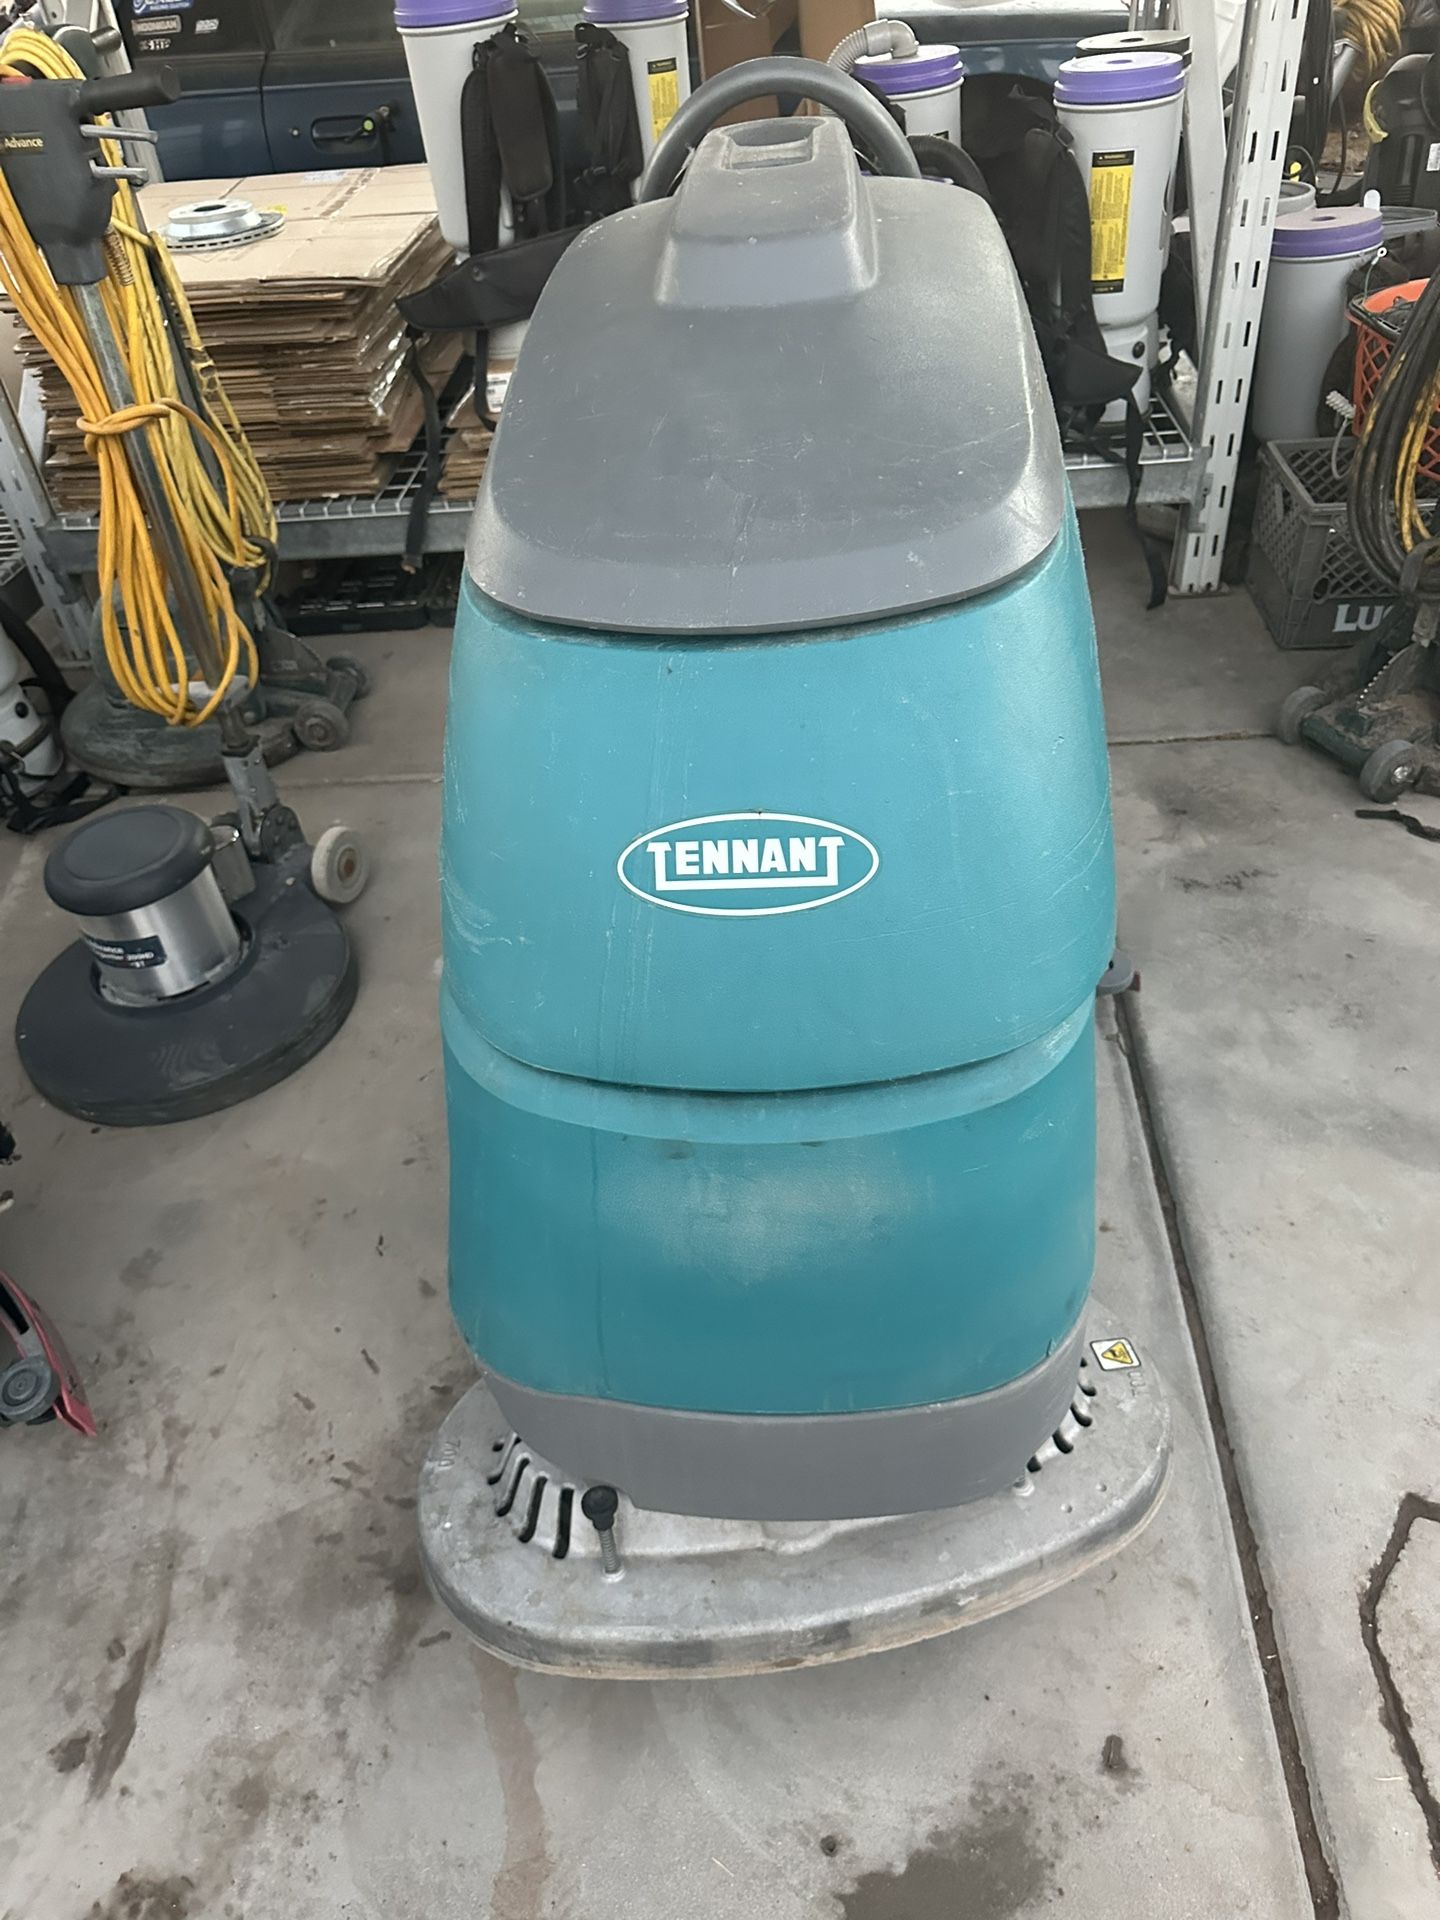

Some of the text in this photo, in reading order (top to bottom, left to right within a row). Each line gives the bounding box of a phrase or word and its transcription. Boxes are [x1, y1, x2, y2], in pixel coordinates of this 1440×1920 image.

[4, 136, 44, 148] Advance
[1331, 603, 1394, 633] LU
[646, 836, 845, 890] TENNANT
